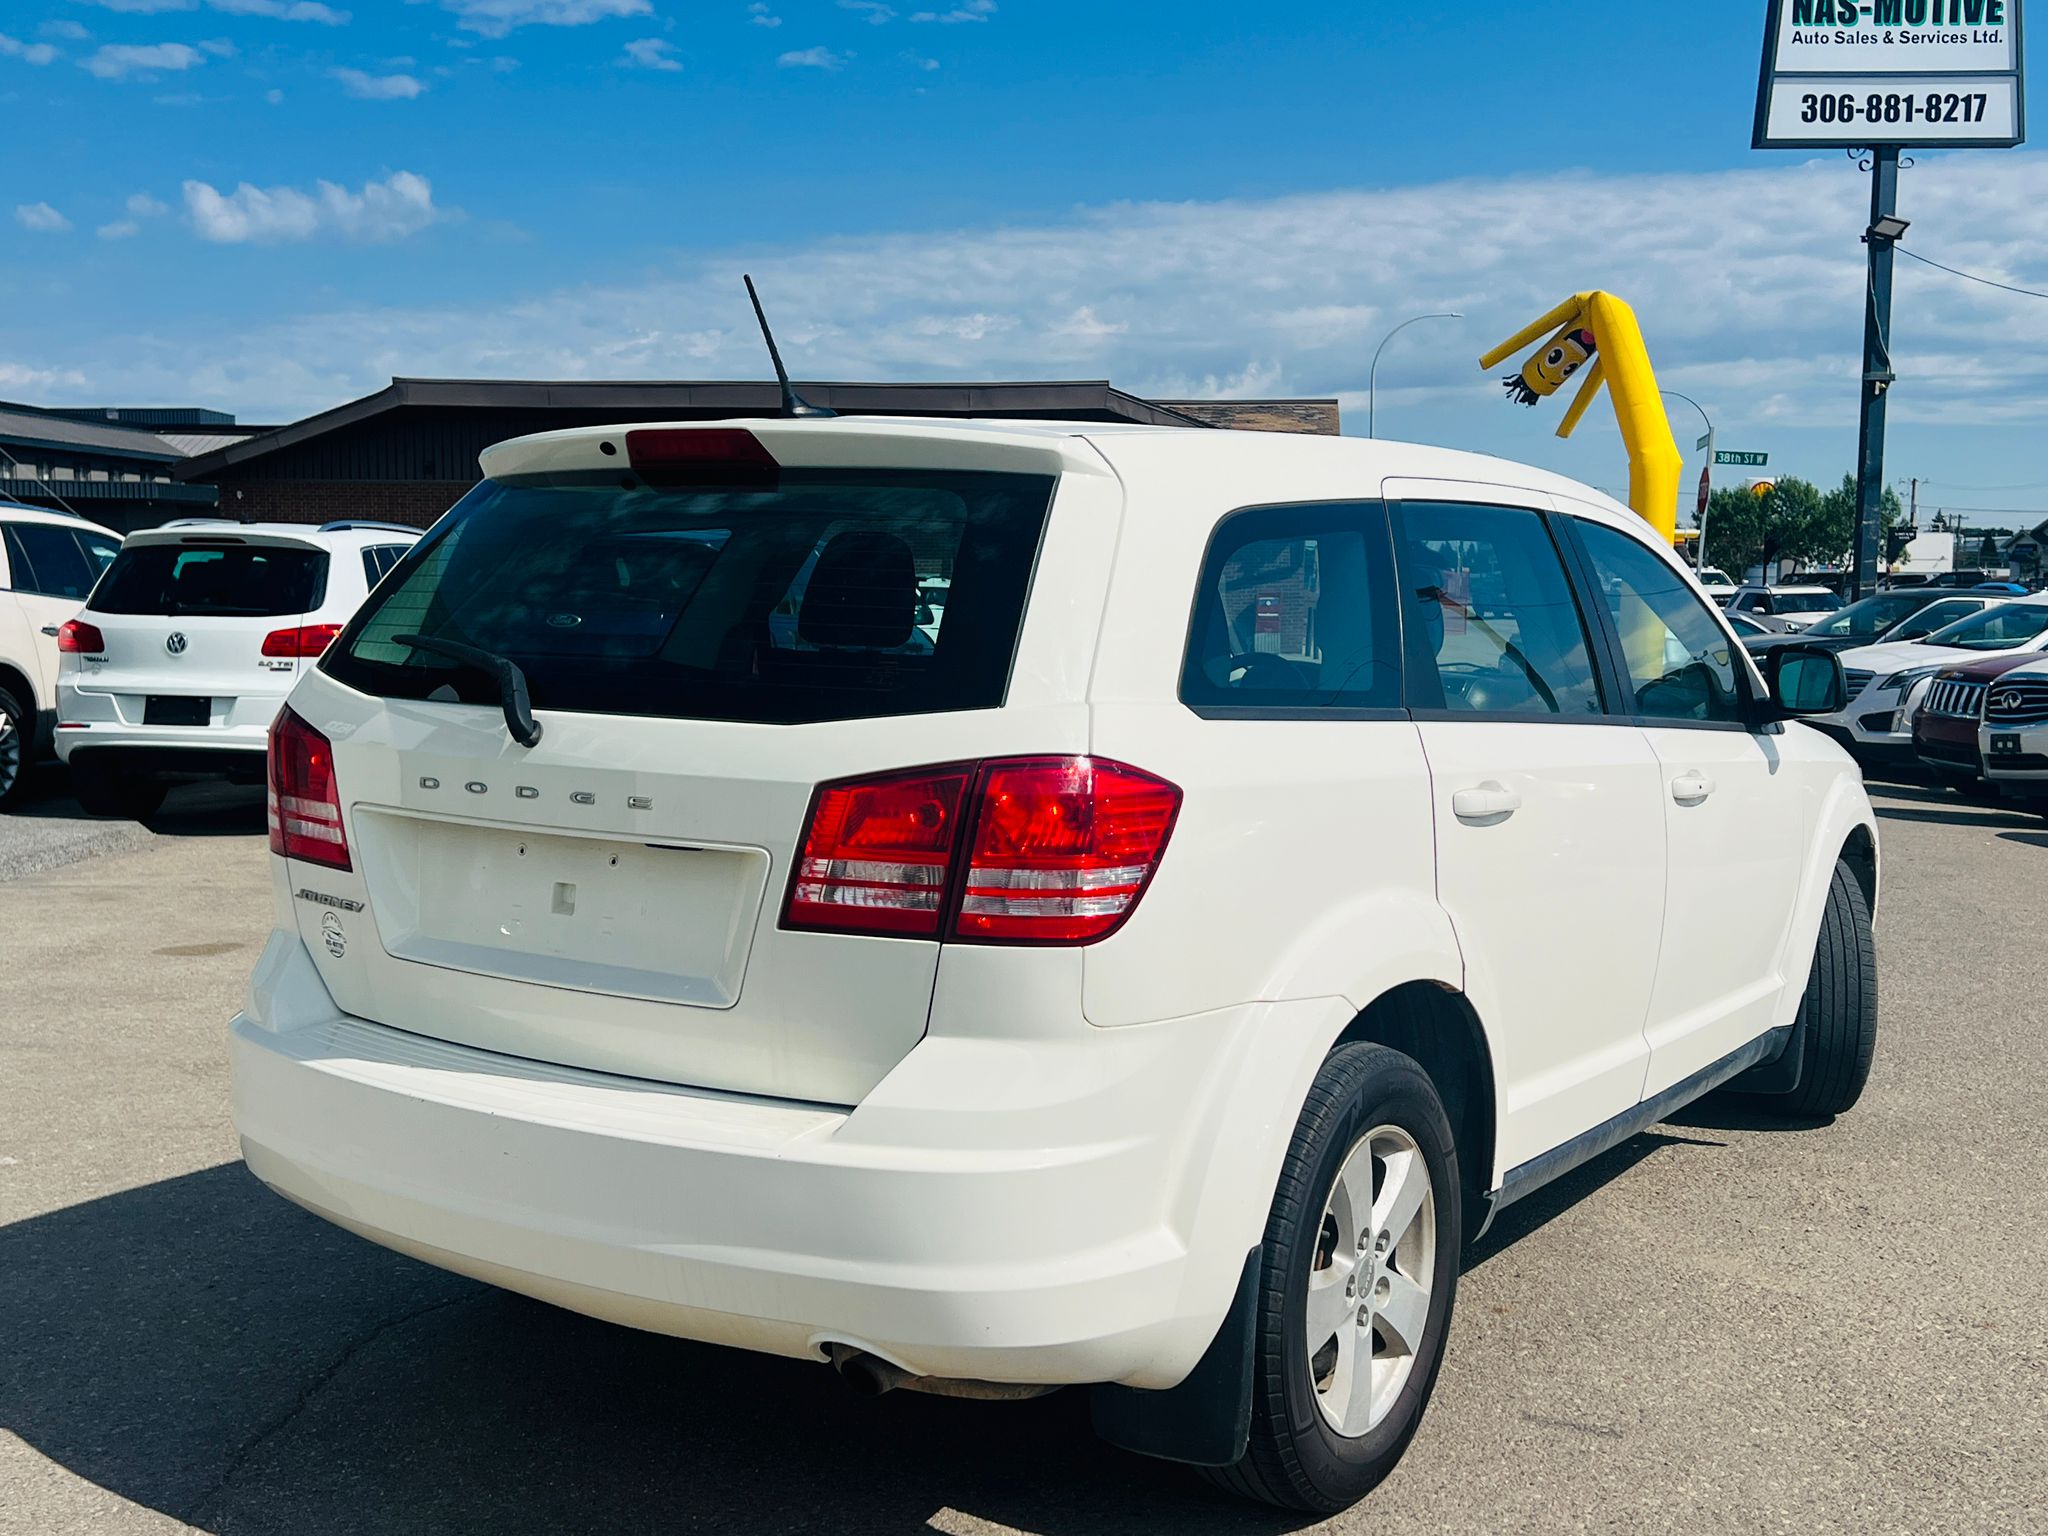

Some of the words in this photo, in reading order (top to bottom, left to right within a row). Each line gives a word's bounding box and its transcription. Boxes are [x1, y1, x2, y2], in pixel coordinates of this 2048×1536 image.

[1792, 30, 1829, 45] Auto
[1834, 30, 1878, 45] Sales
[1883, 30, 1894, 45] &
[1899, 30, 1967, 45] Services
[1973, 29, 2003, 44] Ltd.
[1801, 93, 1987, 123] 306-881-8217
[1717, 452, 1741, 464] 38th
[1743, 453, 1754, 464] ST
[419, 776, 653, 811] DODGE
